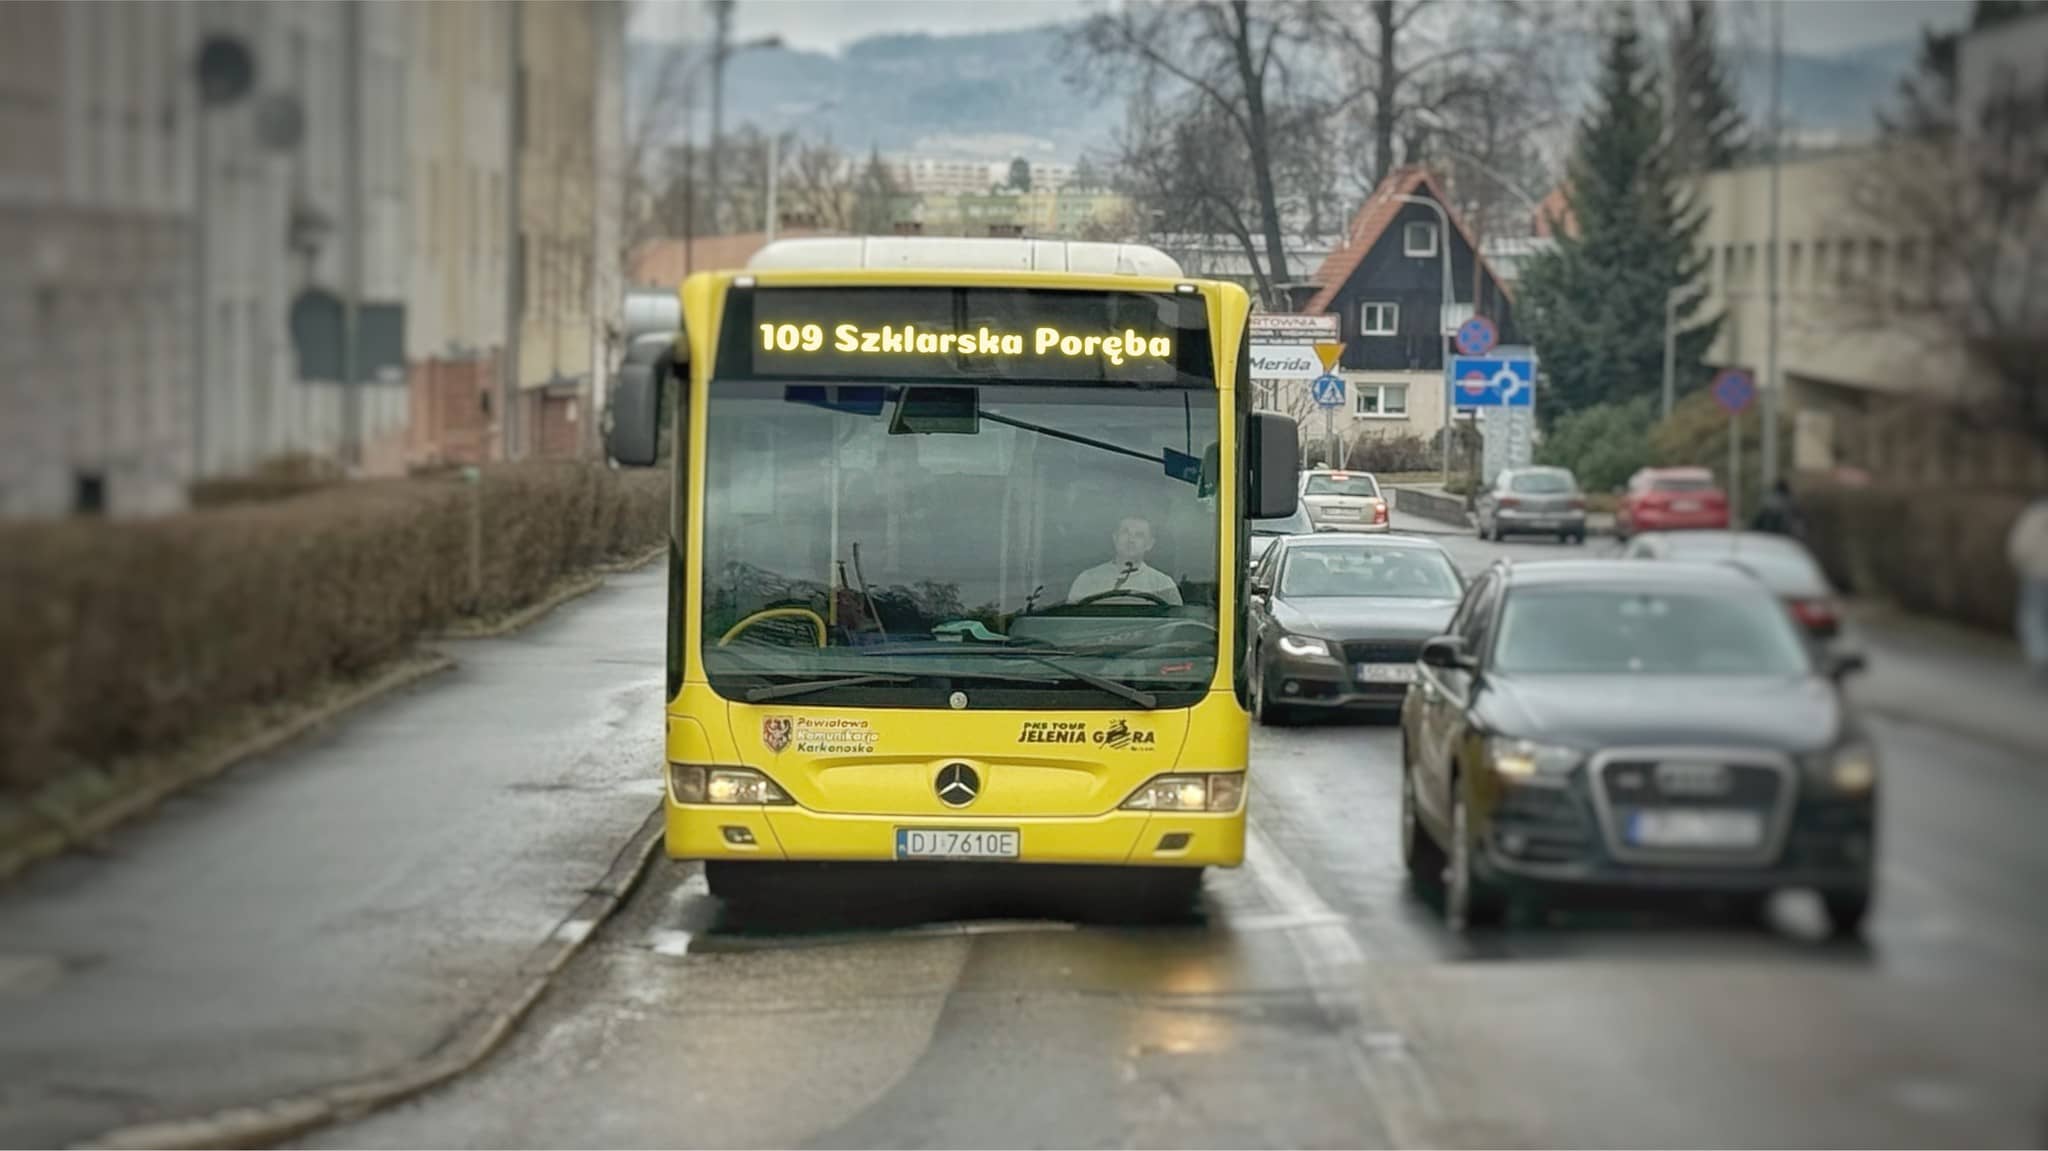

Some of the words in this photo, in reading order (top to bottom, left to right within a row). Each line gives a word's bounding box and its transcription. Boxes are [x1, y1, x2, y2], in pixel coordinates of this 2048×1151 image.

[760, 323, 824, 352] 109
[834, 324, 1023, 355] Szklarska
[1035, 327, 1171, 365] Poręba
[1250, 356, 1311, 370] Merida
[1023, 722, 1048, 730] PKS
[1052, 722, 1086, 730] TOUR
[1018, 731, 1086, 743] JELENIA
[912, 833, 937, 853] DJ
[947, 833, 1013, 854] 7610E
